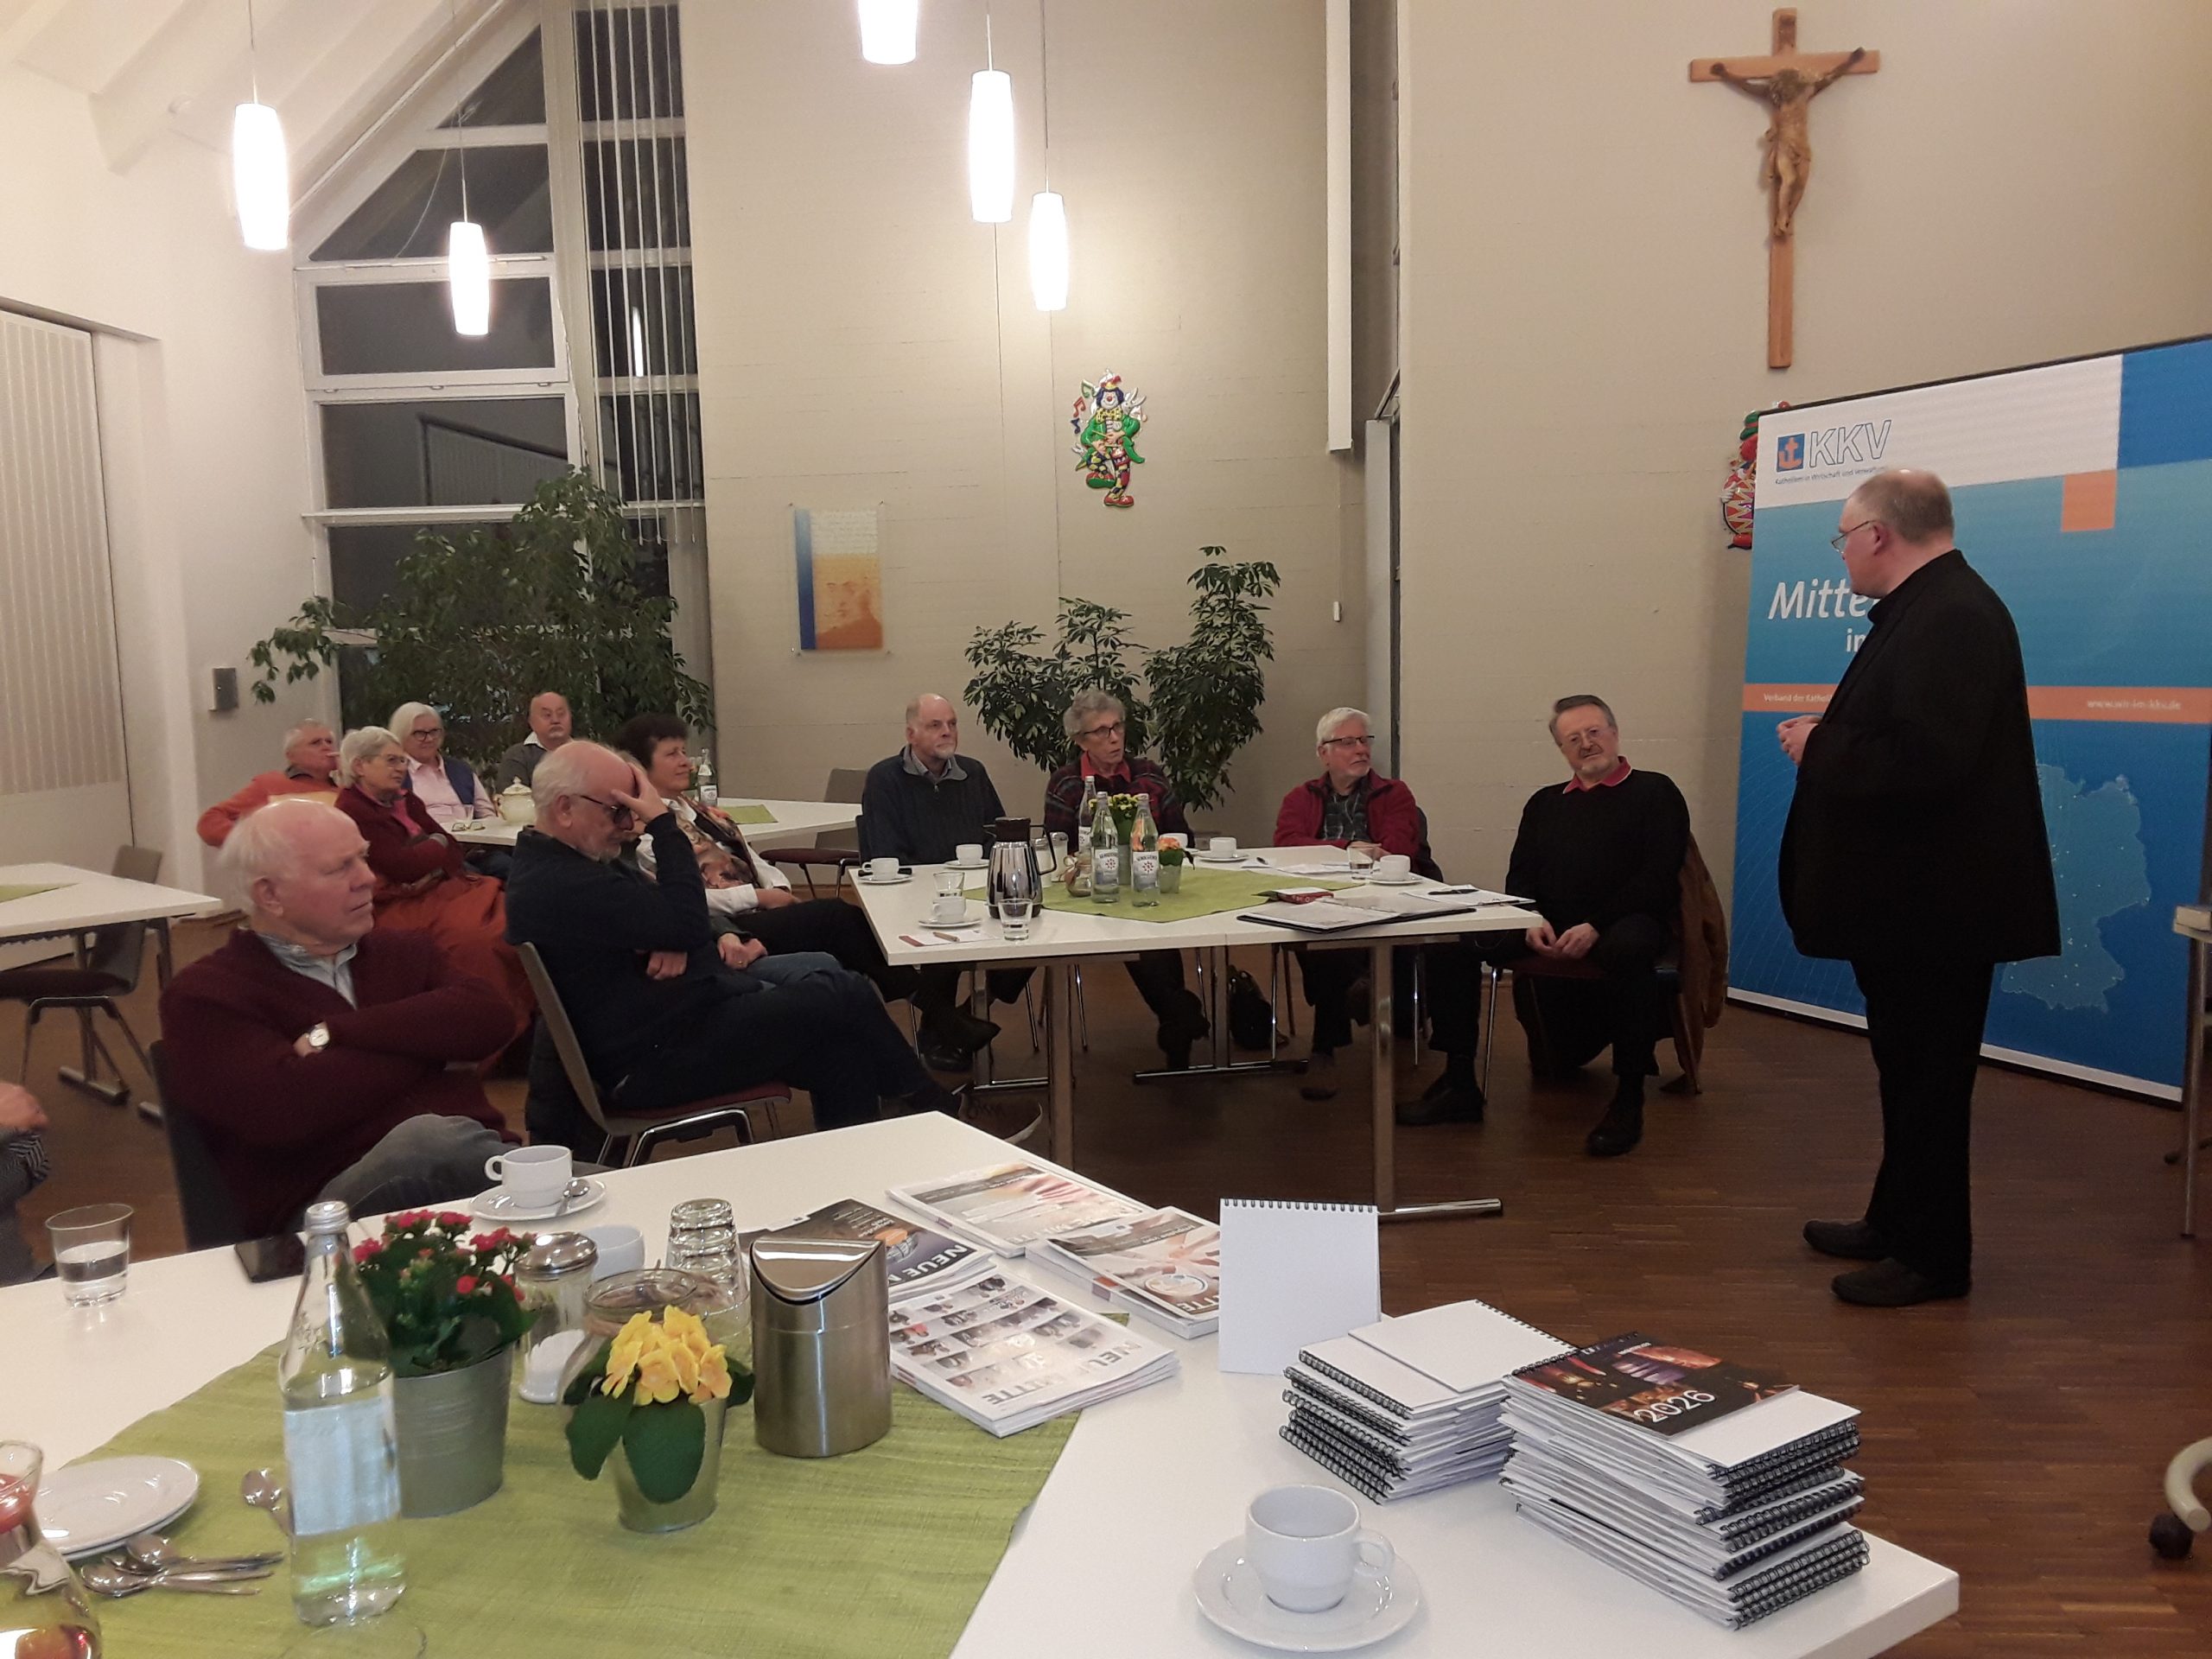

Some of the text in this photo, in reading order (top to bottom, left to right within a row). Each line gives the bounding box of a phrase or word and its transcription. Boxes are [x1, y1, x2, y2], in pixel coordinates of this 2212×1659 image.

[1809, 420, 1891, 467] KKV
[1768, 577, 1881, 620] Mitte
[902, 1244, 968, 1277] NEUE
[1634, 1389, 1716, 1423] 2026
